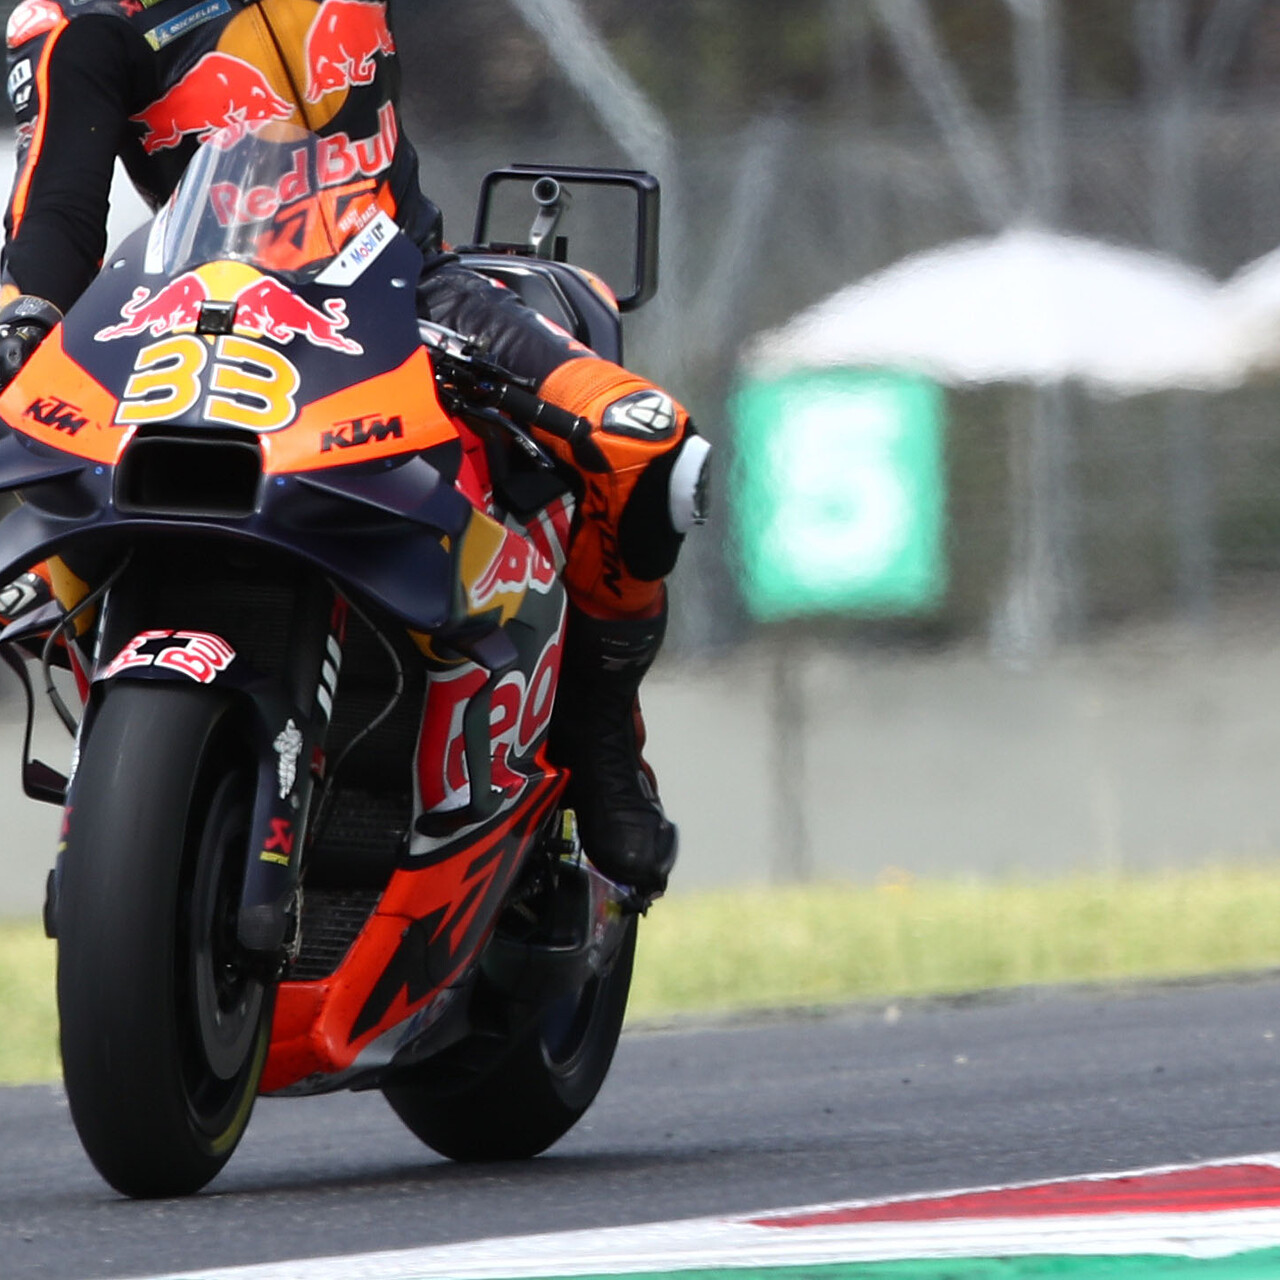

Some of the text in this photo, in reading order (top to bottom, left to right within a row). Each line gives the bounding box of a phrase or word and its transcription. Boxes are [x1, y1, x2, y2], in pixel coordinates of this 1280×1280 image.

[209, 146, 312, 227] Red
[314, 99, 399, 187] Bull
[349, 232, 378, 267] Mobil
[115, 335, 302, 431] 33
[23, 396, 89, 436] KTM
[321, 414, 406, 453] KTM
[154, 629, 237, 685] Bull
